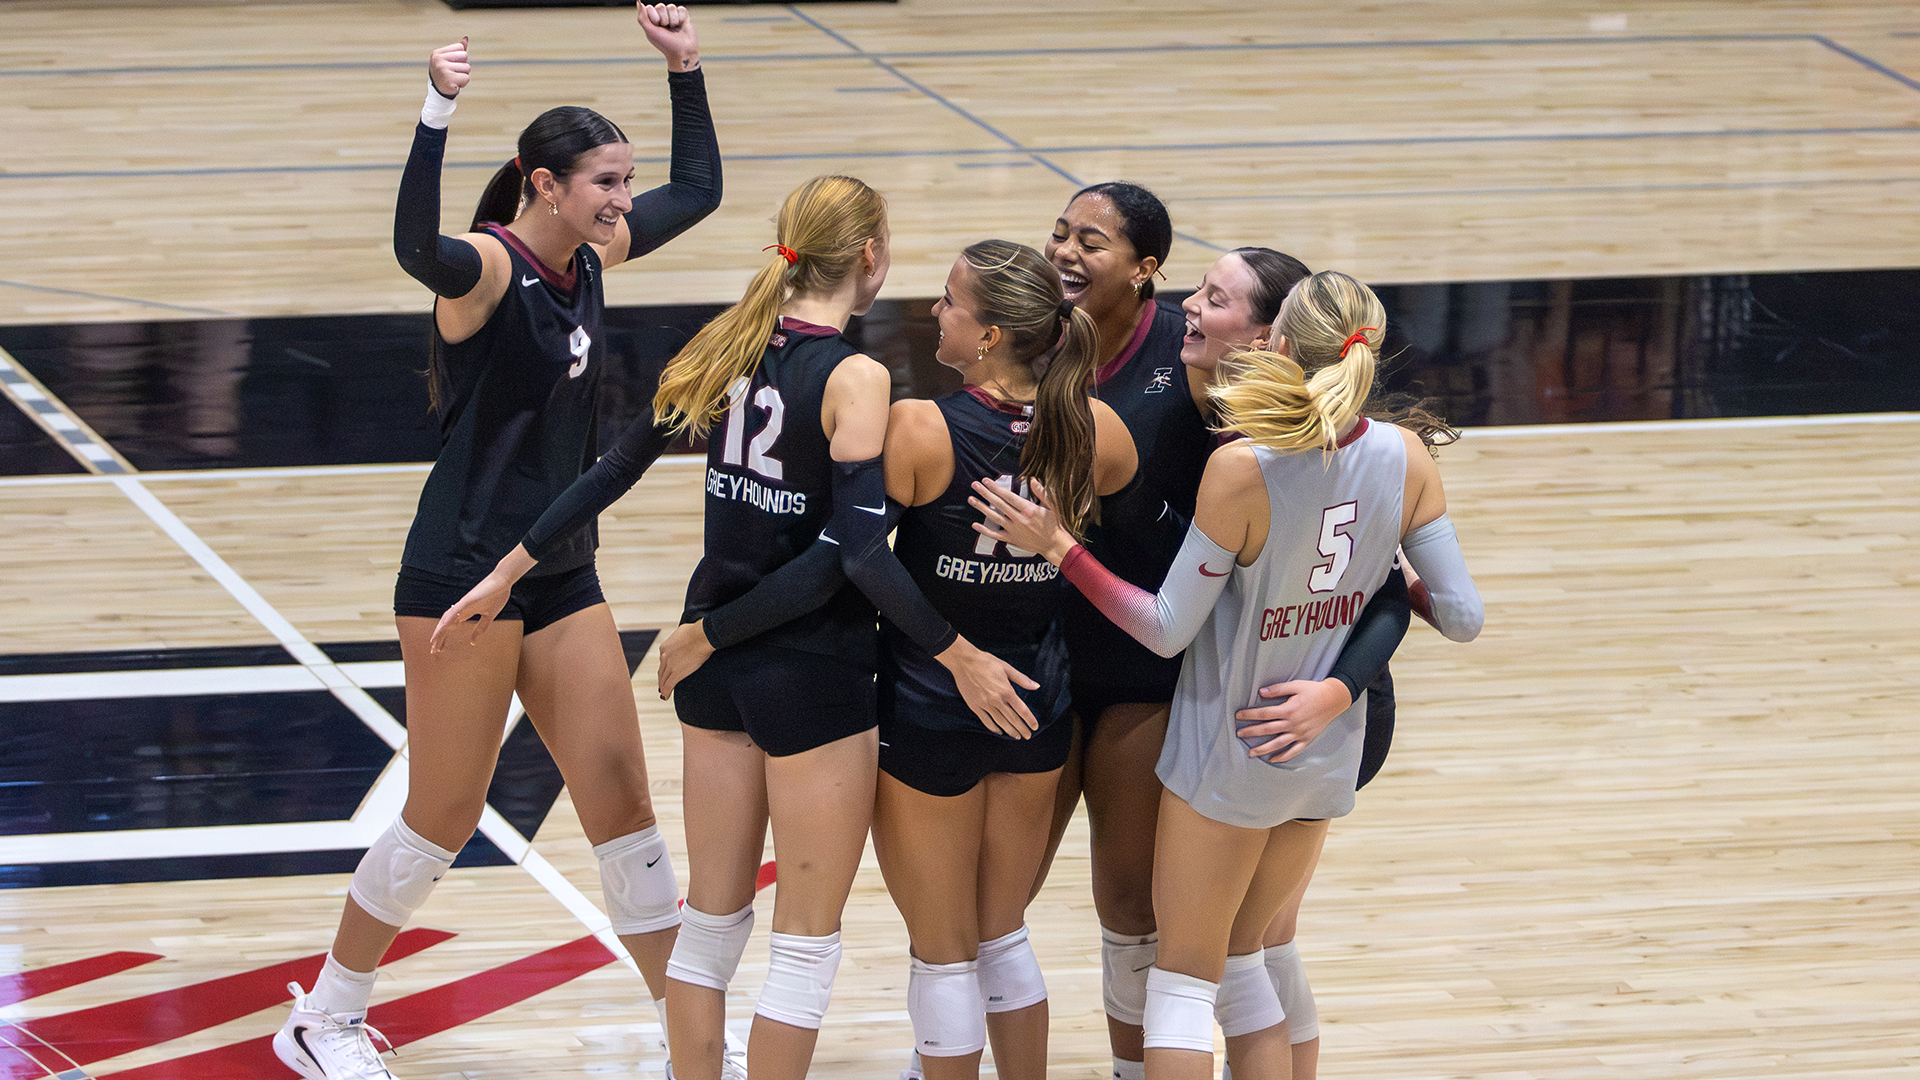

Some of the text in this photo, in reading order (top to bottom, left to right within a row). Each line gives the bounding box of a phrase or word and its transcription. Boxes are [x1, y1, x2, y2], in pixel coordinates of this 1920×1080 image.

[569, 324, 592, 379] 9
[722, 374, 785, 481] 12
[706, 467, 806, 515] GREYHOUNDS
[935, 554, 1060, 583] GREYHOUNDS
[1307, 500, 1358, 594] 5
